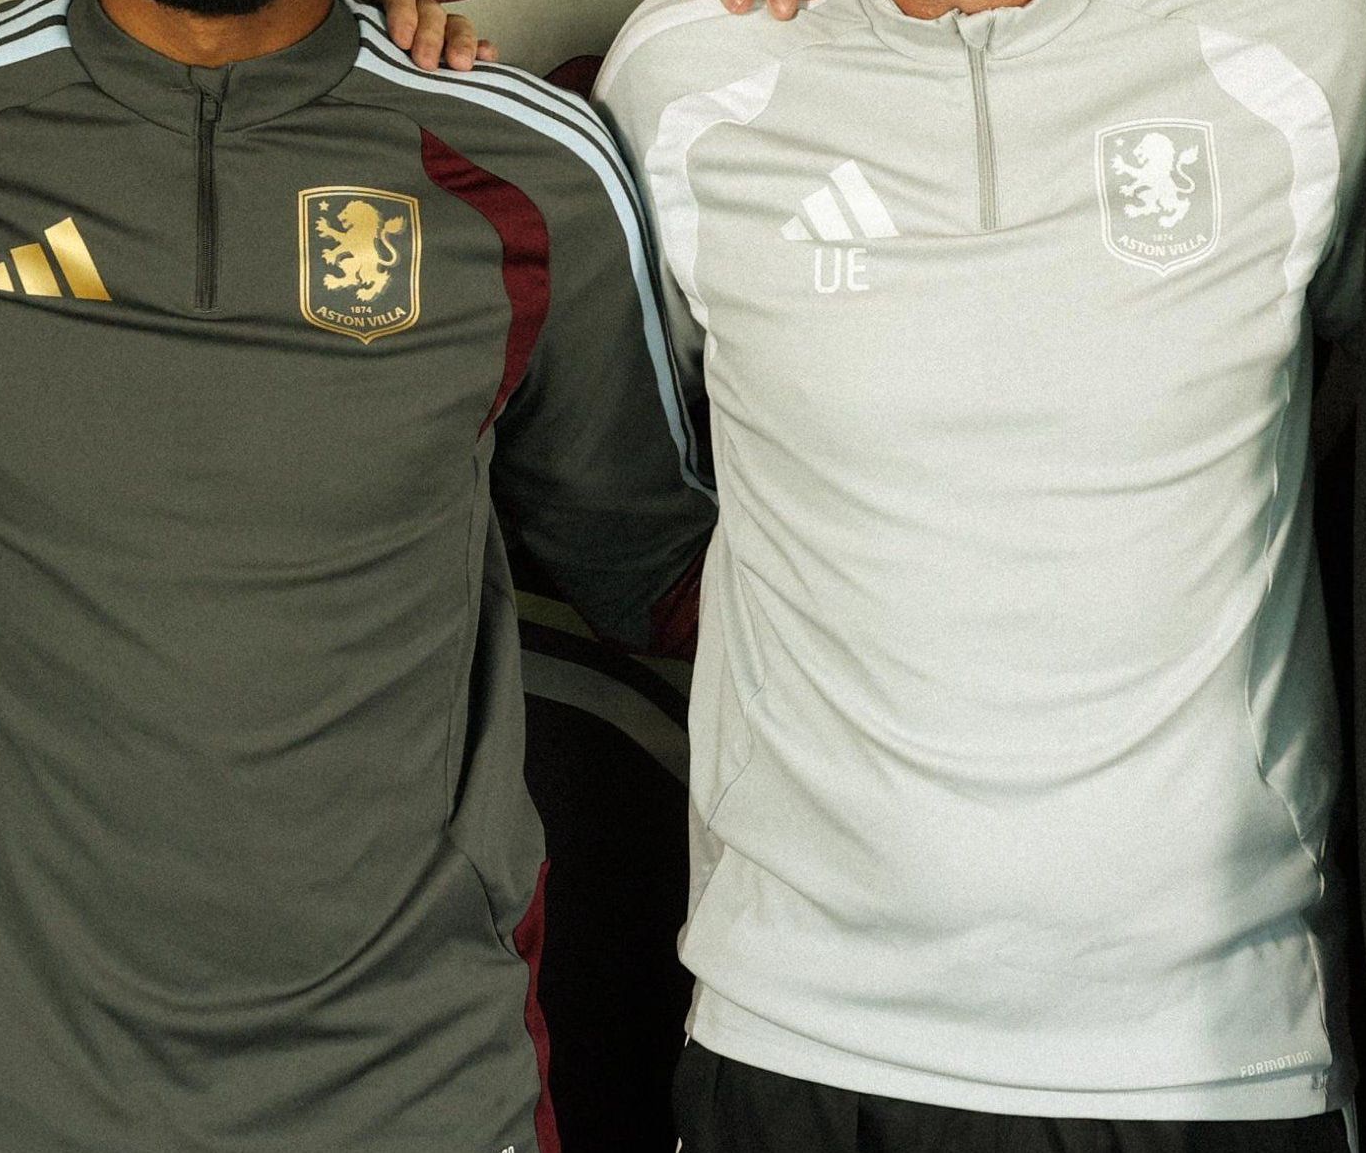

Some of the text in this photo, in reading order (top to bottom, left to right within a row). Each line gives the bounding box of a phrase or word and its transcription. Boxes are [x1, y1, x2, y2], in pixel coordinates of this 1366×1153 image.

[1118, 234, 1207, 256] ASTON VILLA
[814, 247, 870, 294] UE
[316, 306, 407, 327] ASTON VILLA
[350, 306, 373, 314] 1874
